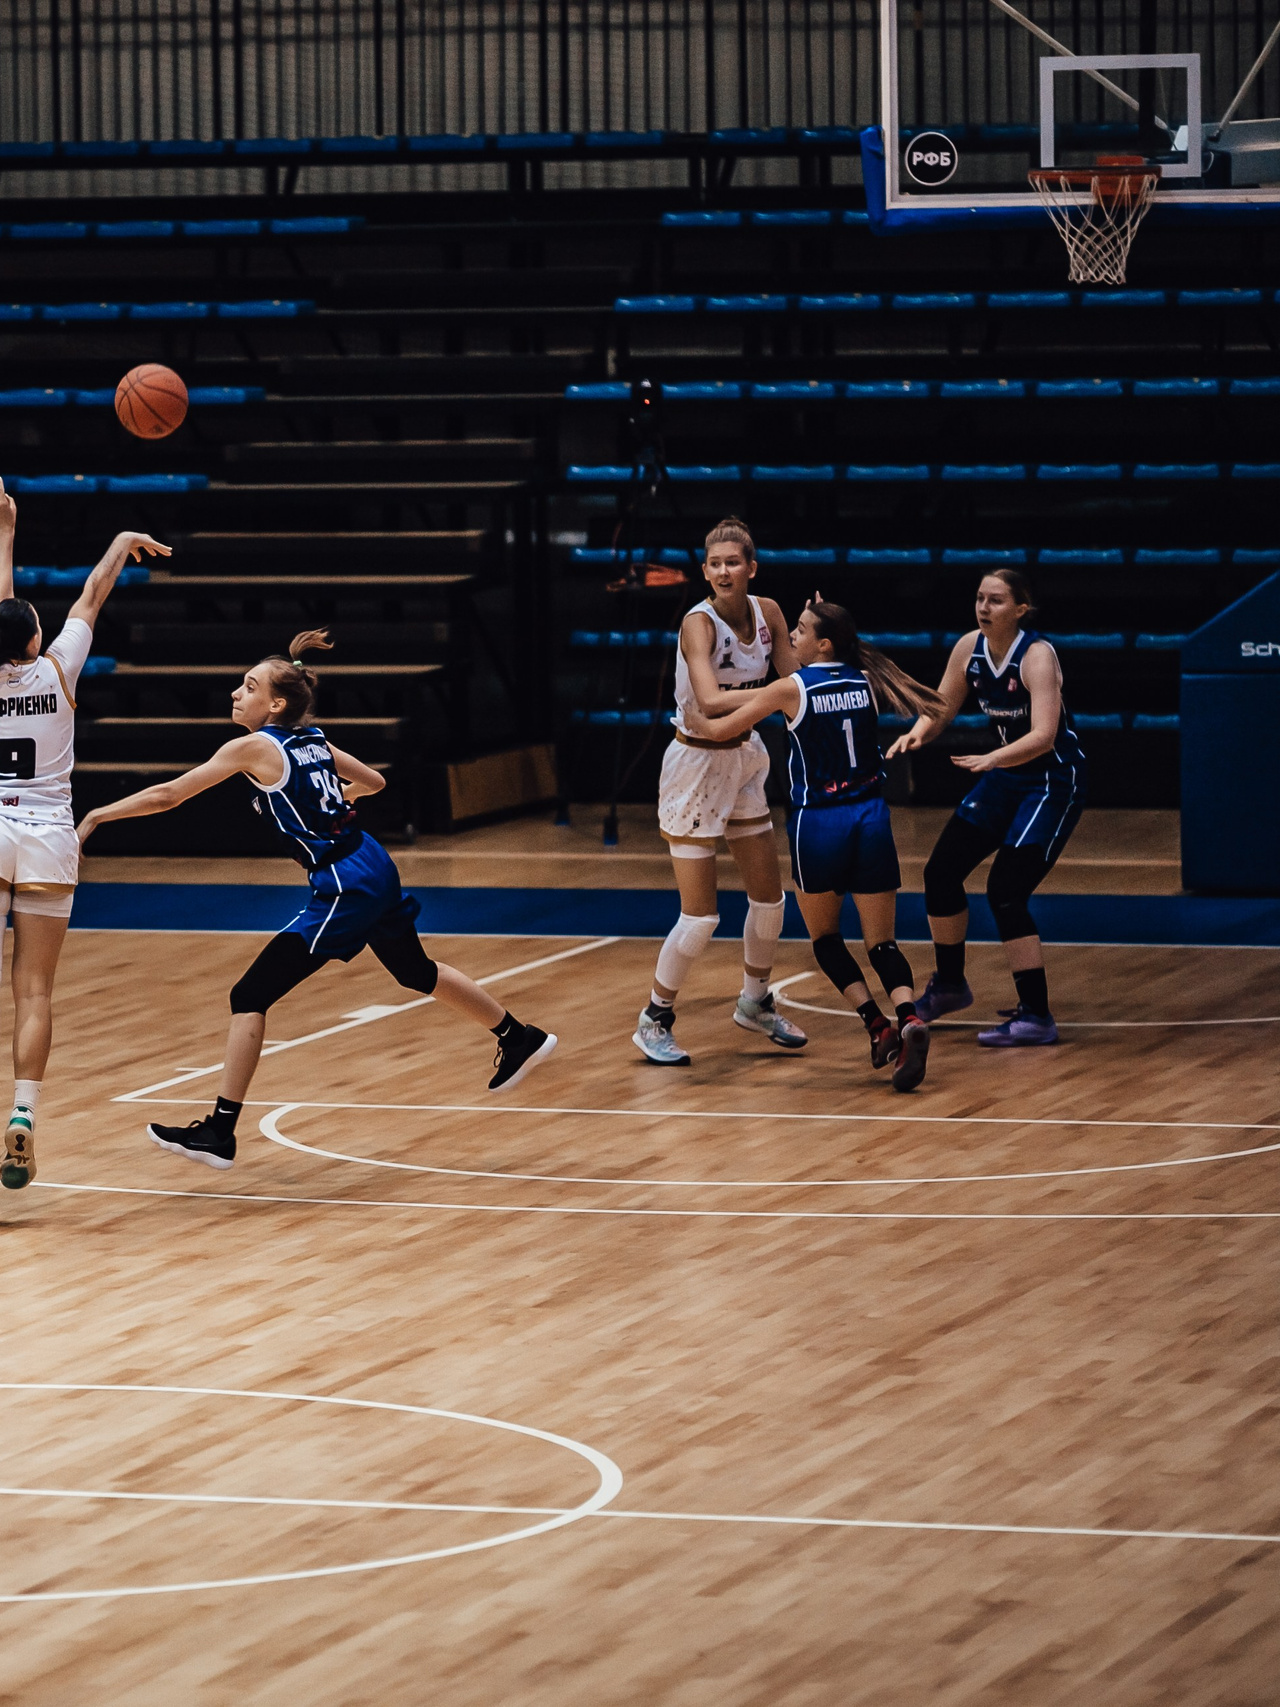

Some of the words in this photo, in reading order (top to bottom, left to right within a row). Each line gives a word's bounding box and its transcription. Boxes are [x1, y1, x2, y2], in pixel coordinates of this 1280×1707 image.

[912, 151, 951, 167] РФБ
[811, 689, 870, 714] МИХАЛЕВА
[842, 718, 857, 768] 1
